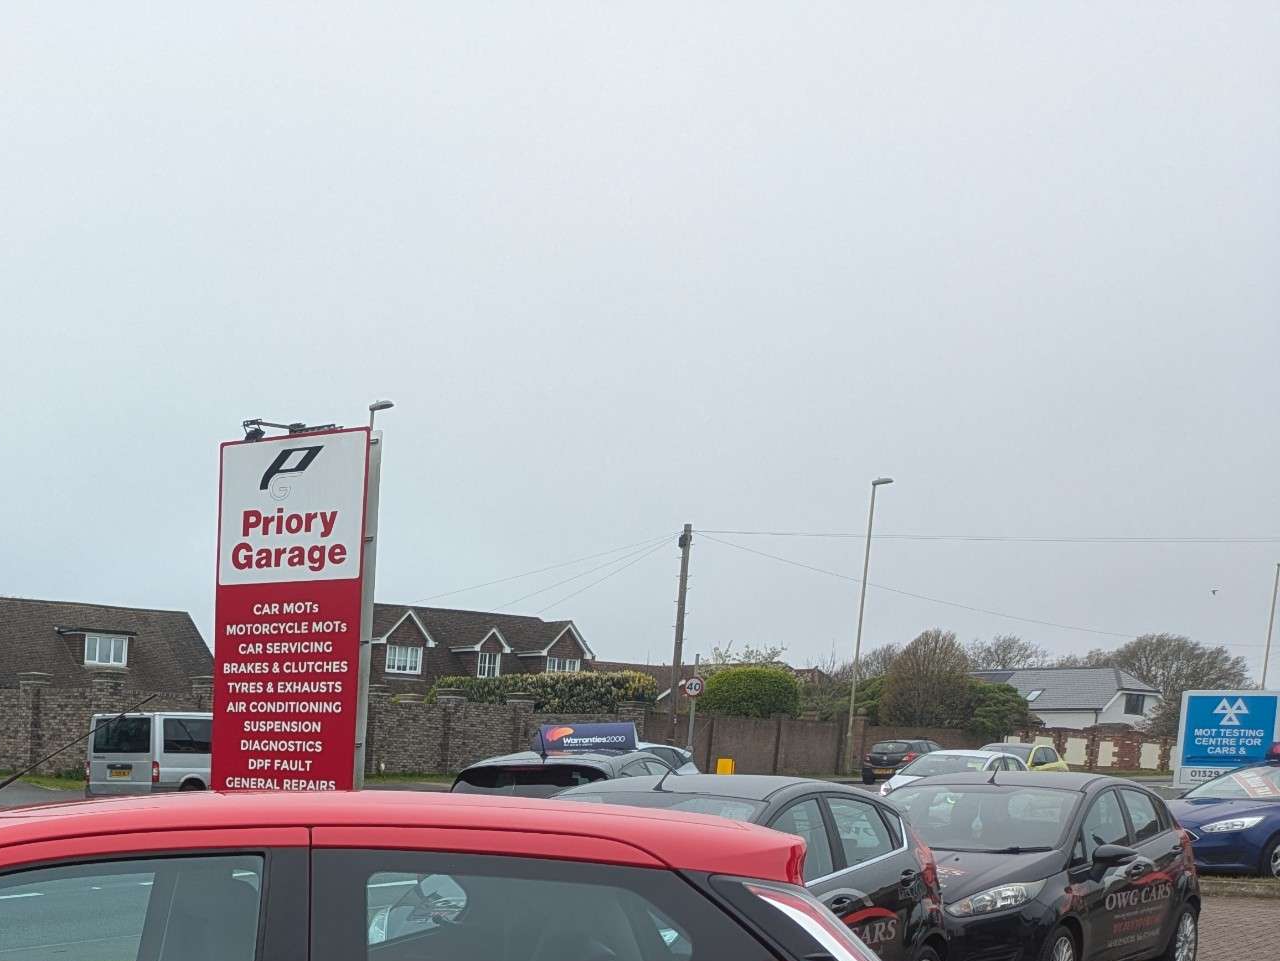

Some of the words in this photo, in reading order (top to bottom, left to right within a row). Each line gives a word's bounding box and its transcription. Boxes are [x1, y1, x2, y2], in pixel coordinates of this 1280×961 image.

[242, 507, 338, 538] Priory
[231, 542, 347, 572] Garage
[253, 603, 279, 616] CAR
[283, 602, 319, 614] MOTs
[226, 622, 308, 636] MOTORCYCLE
[311, 621, 347, 633] MOTs
[238, 643, 263, 655] CAR
[266, 641, 333, 654] SERVICING
[223, 663, 269, 674] BRAKES
[272, 662, 280, 673] &
[283, 661, 348, 673] CLUTCHES
[227, 682, 263, 694] TYRES
[266, 682, 274, 693] &
[277, 681, 342, 693] EXHAUSTS
[687, 683, 701, 691] 40
[226, 702, 246, 713] AIR
[249, 702, 342, 713] CONDITIONING
[243, 721, 321, 733] SUSPENSION
[1194, 728, 1217, 736] MOT
[1219, 729, 1264, 737] TESTING
[240, 740, 322, 752] DIAGNOSTICS
[1194, 738, 1237, 746] CENTRE
[1239, 738, 1262, 746] FOR
[248, 759, 271, 771] DPF
[274, 760, 312, 772] FAULT
[1190, 770, 1220, 778] 01329
[225, 777, 280, 790] GENERAL
[283, 779, 336, 791] REPAIRS
[1105, 888, 1139, 911] OWG
[1141, 882, 1172, 903] CARS
